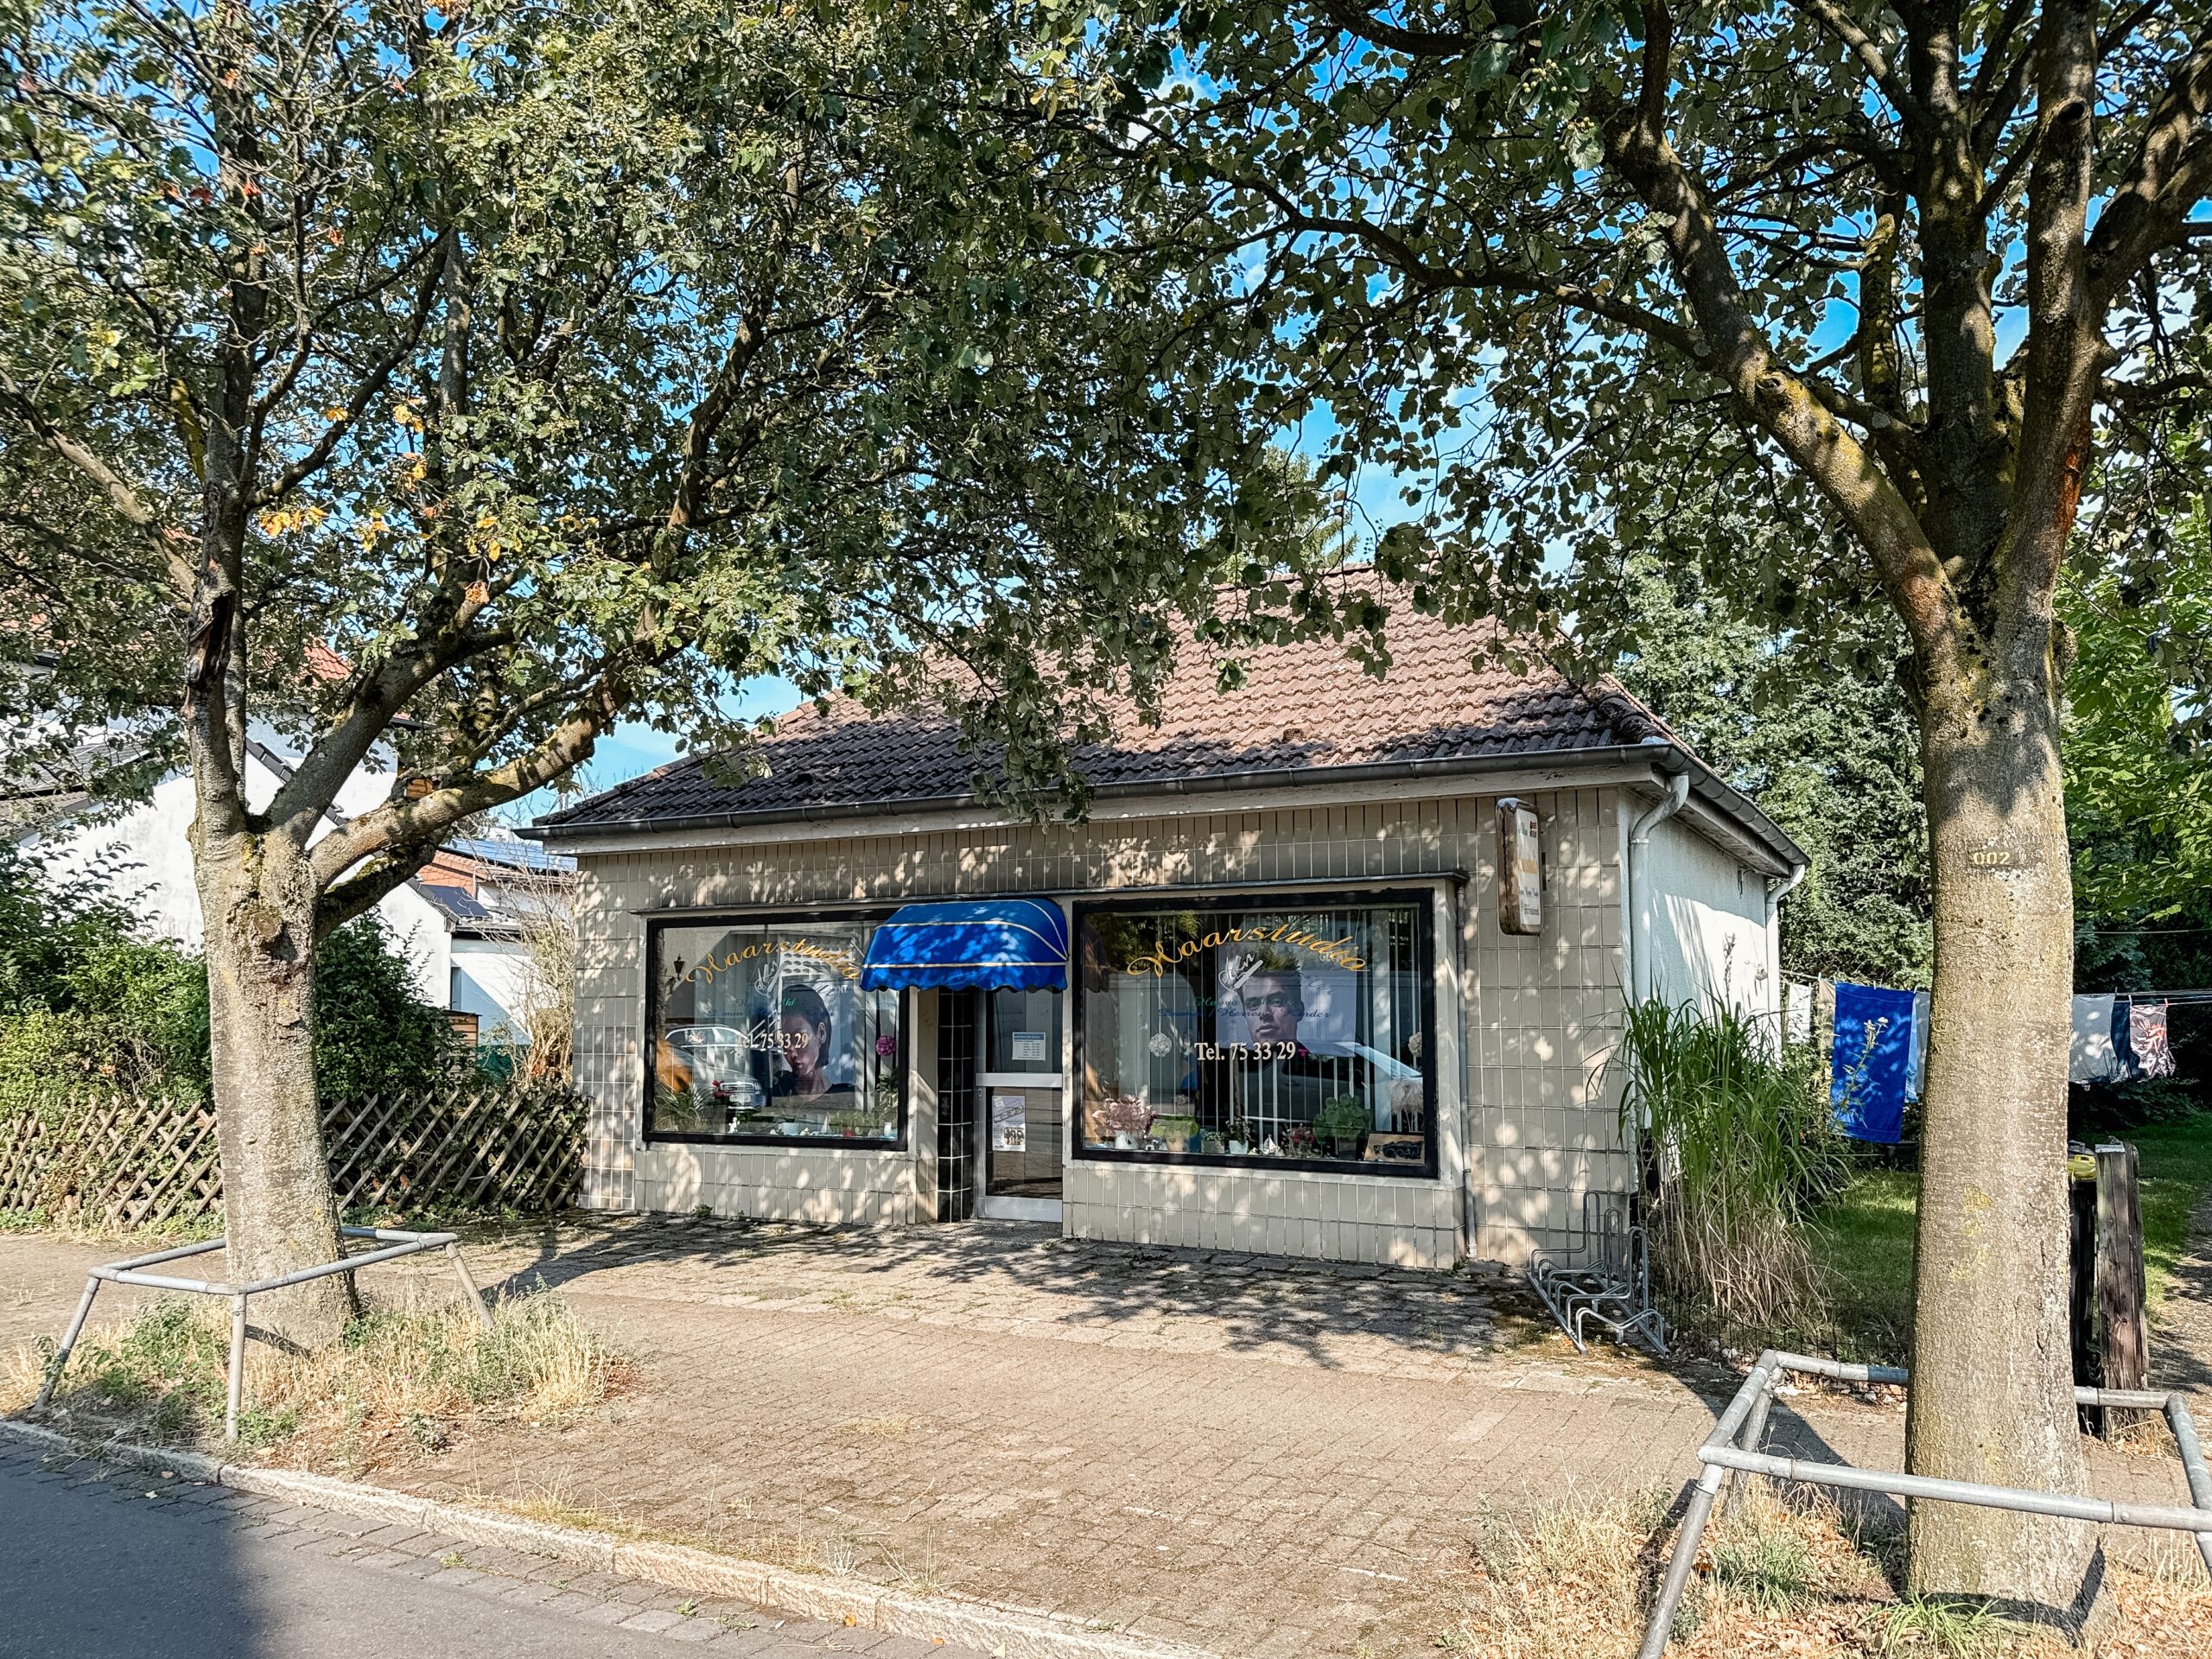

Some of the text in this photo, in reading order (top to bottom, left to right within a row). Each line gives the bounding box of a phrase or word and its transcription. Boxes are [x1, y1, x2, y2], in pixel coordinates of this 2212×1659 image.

[1973, 851, 2011, 865] 002
[1126, 923, 1371, 977] Haarstudio
[794, 1033, 809, 1049] 29
[1194, 1041, 1296, 1060] Tel. 75 33 29
